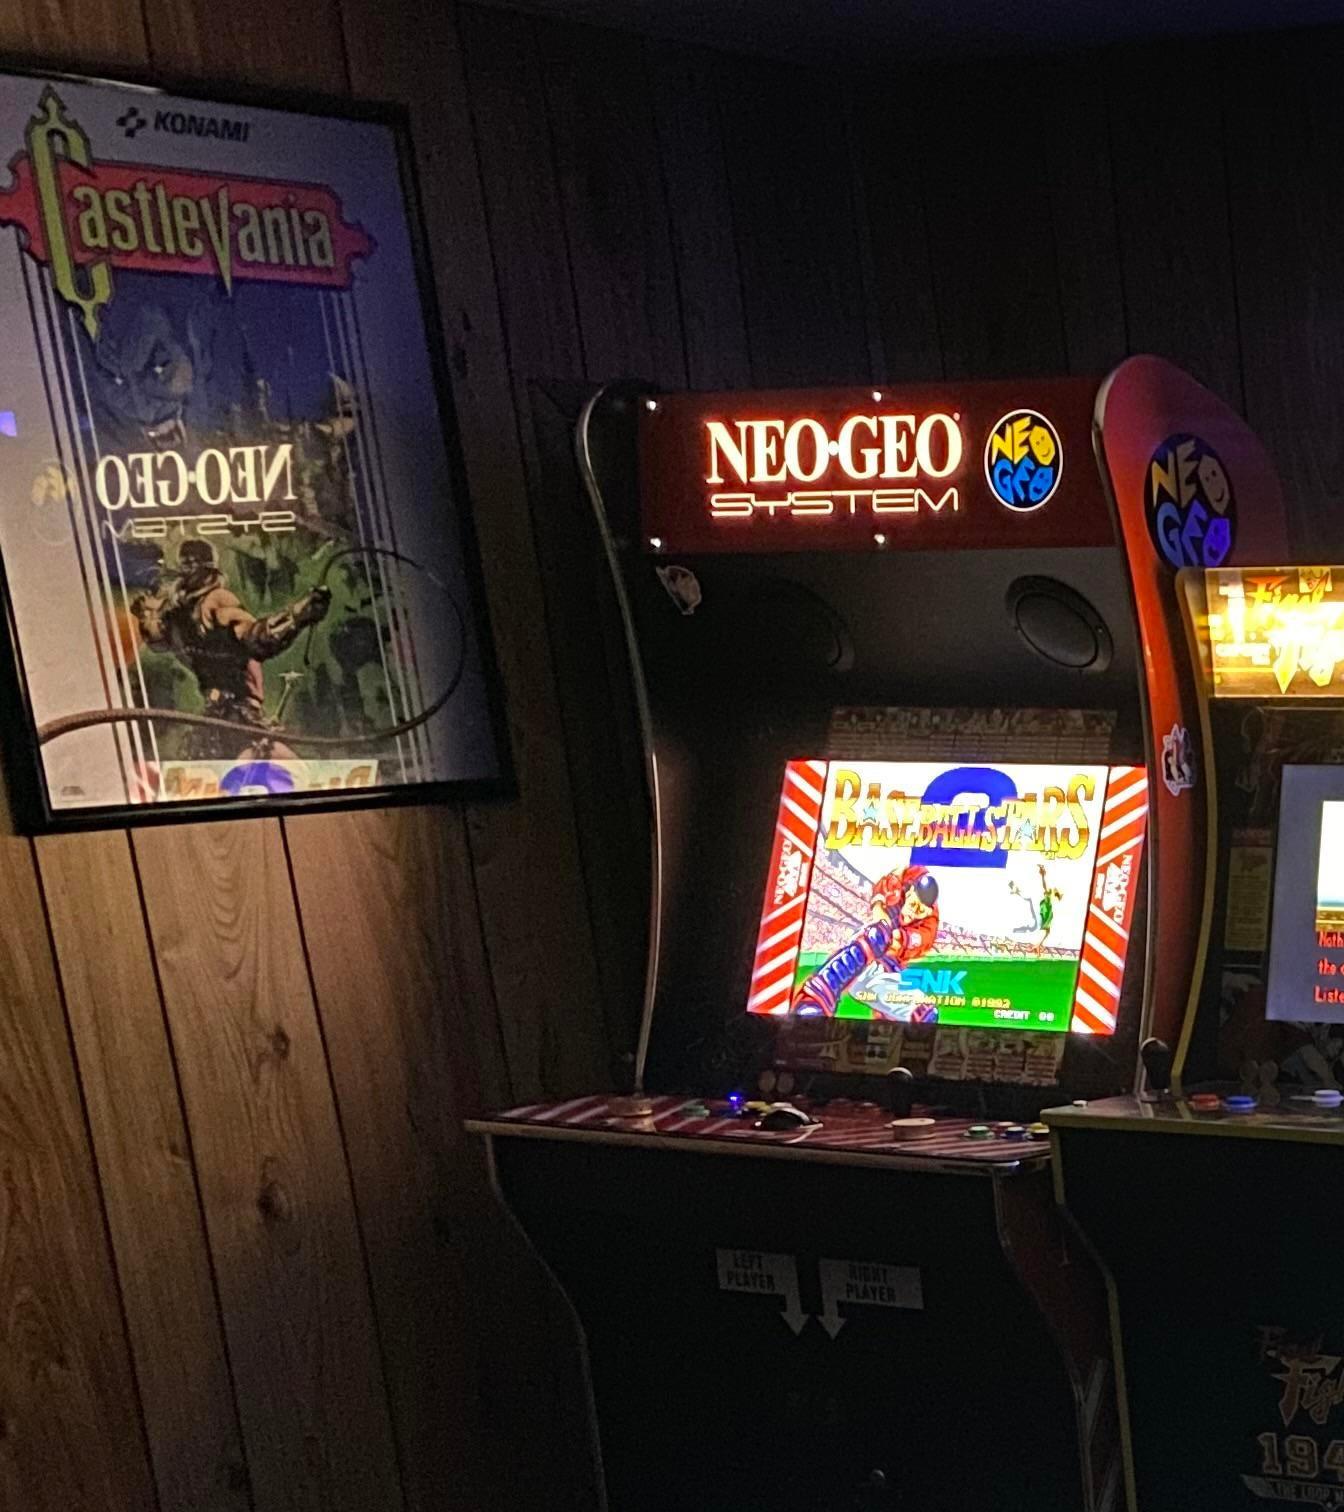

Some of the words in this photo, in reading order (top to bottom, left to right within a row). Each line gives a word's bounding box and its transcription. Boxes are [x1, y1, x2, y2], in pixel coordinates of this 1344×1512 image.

[155, 112, 249, 142] KONAMI
[991, 415, 1057, 467] NEO
[711, 487, 960, 518] SYSTEM
[1318, 957, 1336, 976] the
[898, 967, 969, 996] SNK
[734, 1249, 763, 1269] LEFT
[727, 1270, 776, 1291] PLAYER
[849, 1263, 888, 1283] RIGHT
[846, 1283, 897, 1303] PLAYER
